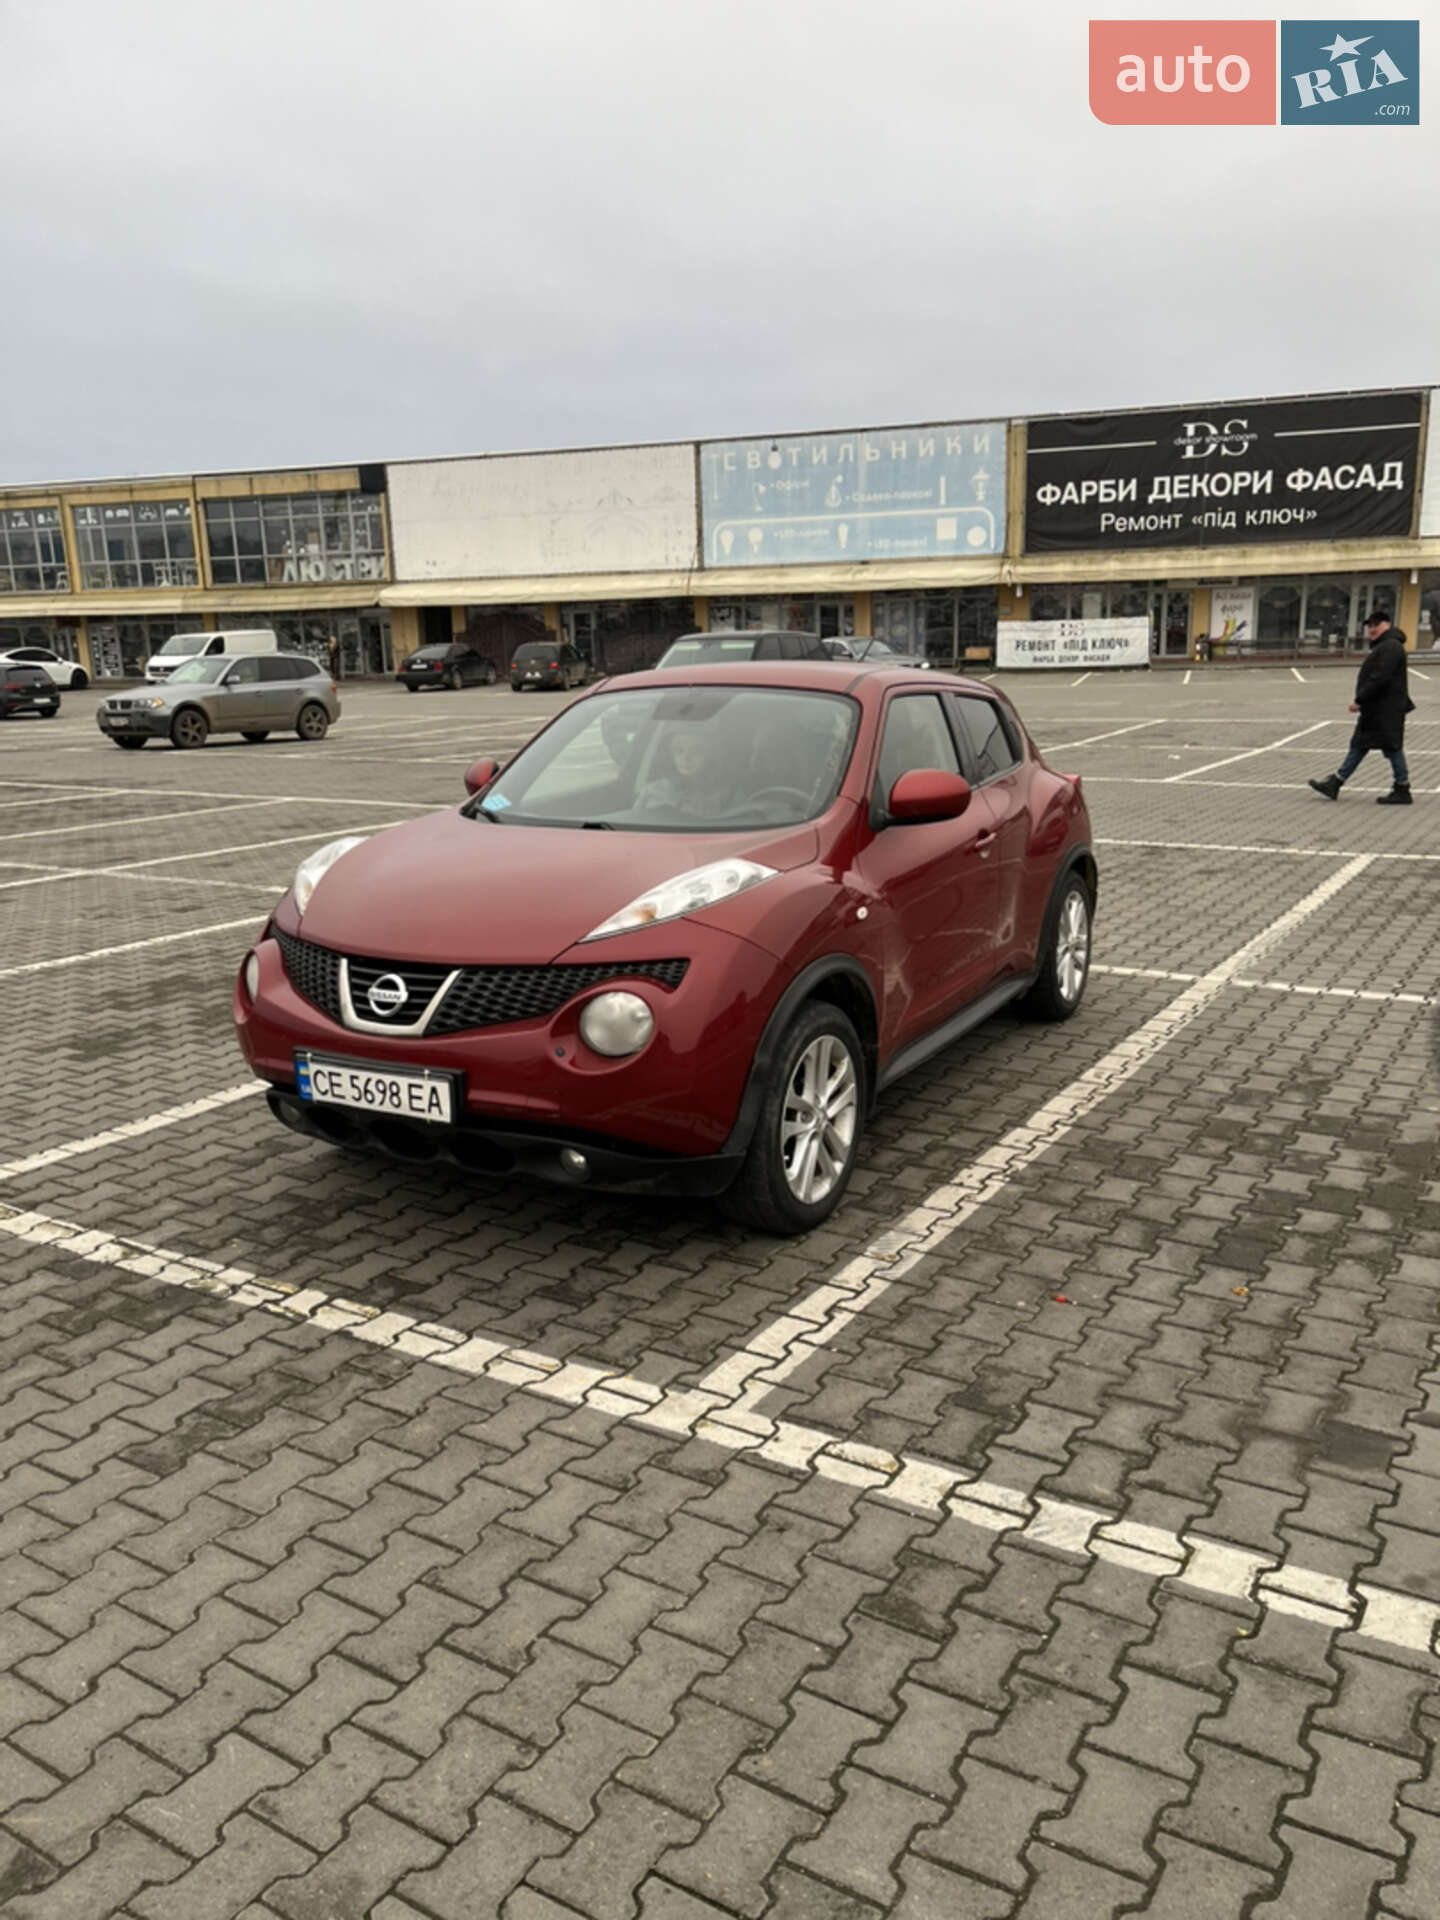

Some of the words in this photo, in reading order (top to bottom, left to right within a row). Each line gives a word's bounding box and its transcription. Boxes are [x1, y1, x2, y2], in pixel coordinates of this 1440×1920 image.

[723, 432, 990, 471] СВТИЛЬНИКИ
[1181, 418, 1249, 460] DS
[1036, 477, 1138, 507] ФАРБИ
[1147, 469, 1274, 505] ДЕКОРИ
[1285, 461, 1405, 493] ФАСАД
[1100, 511, 1183, 533] Ремонт
[1191, 506, 1237, 530] «під
[1245, 507, 1318, 526] ключ»
[1015, 639, 1056, 652] РЕМОНТ
[313, 1069, 346, 1100] CE
[349, 1074, 402, 1109] 5698
[407, 1083, 443, 1116] EA
